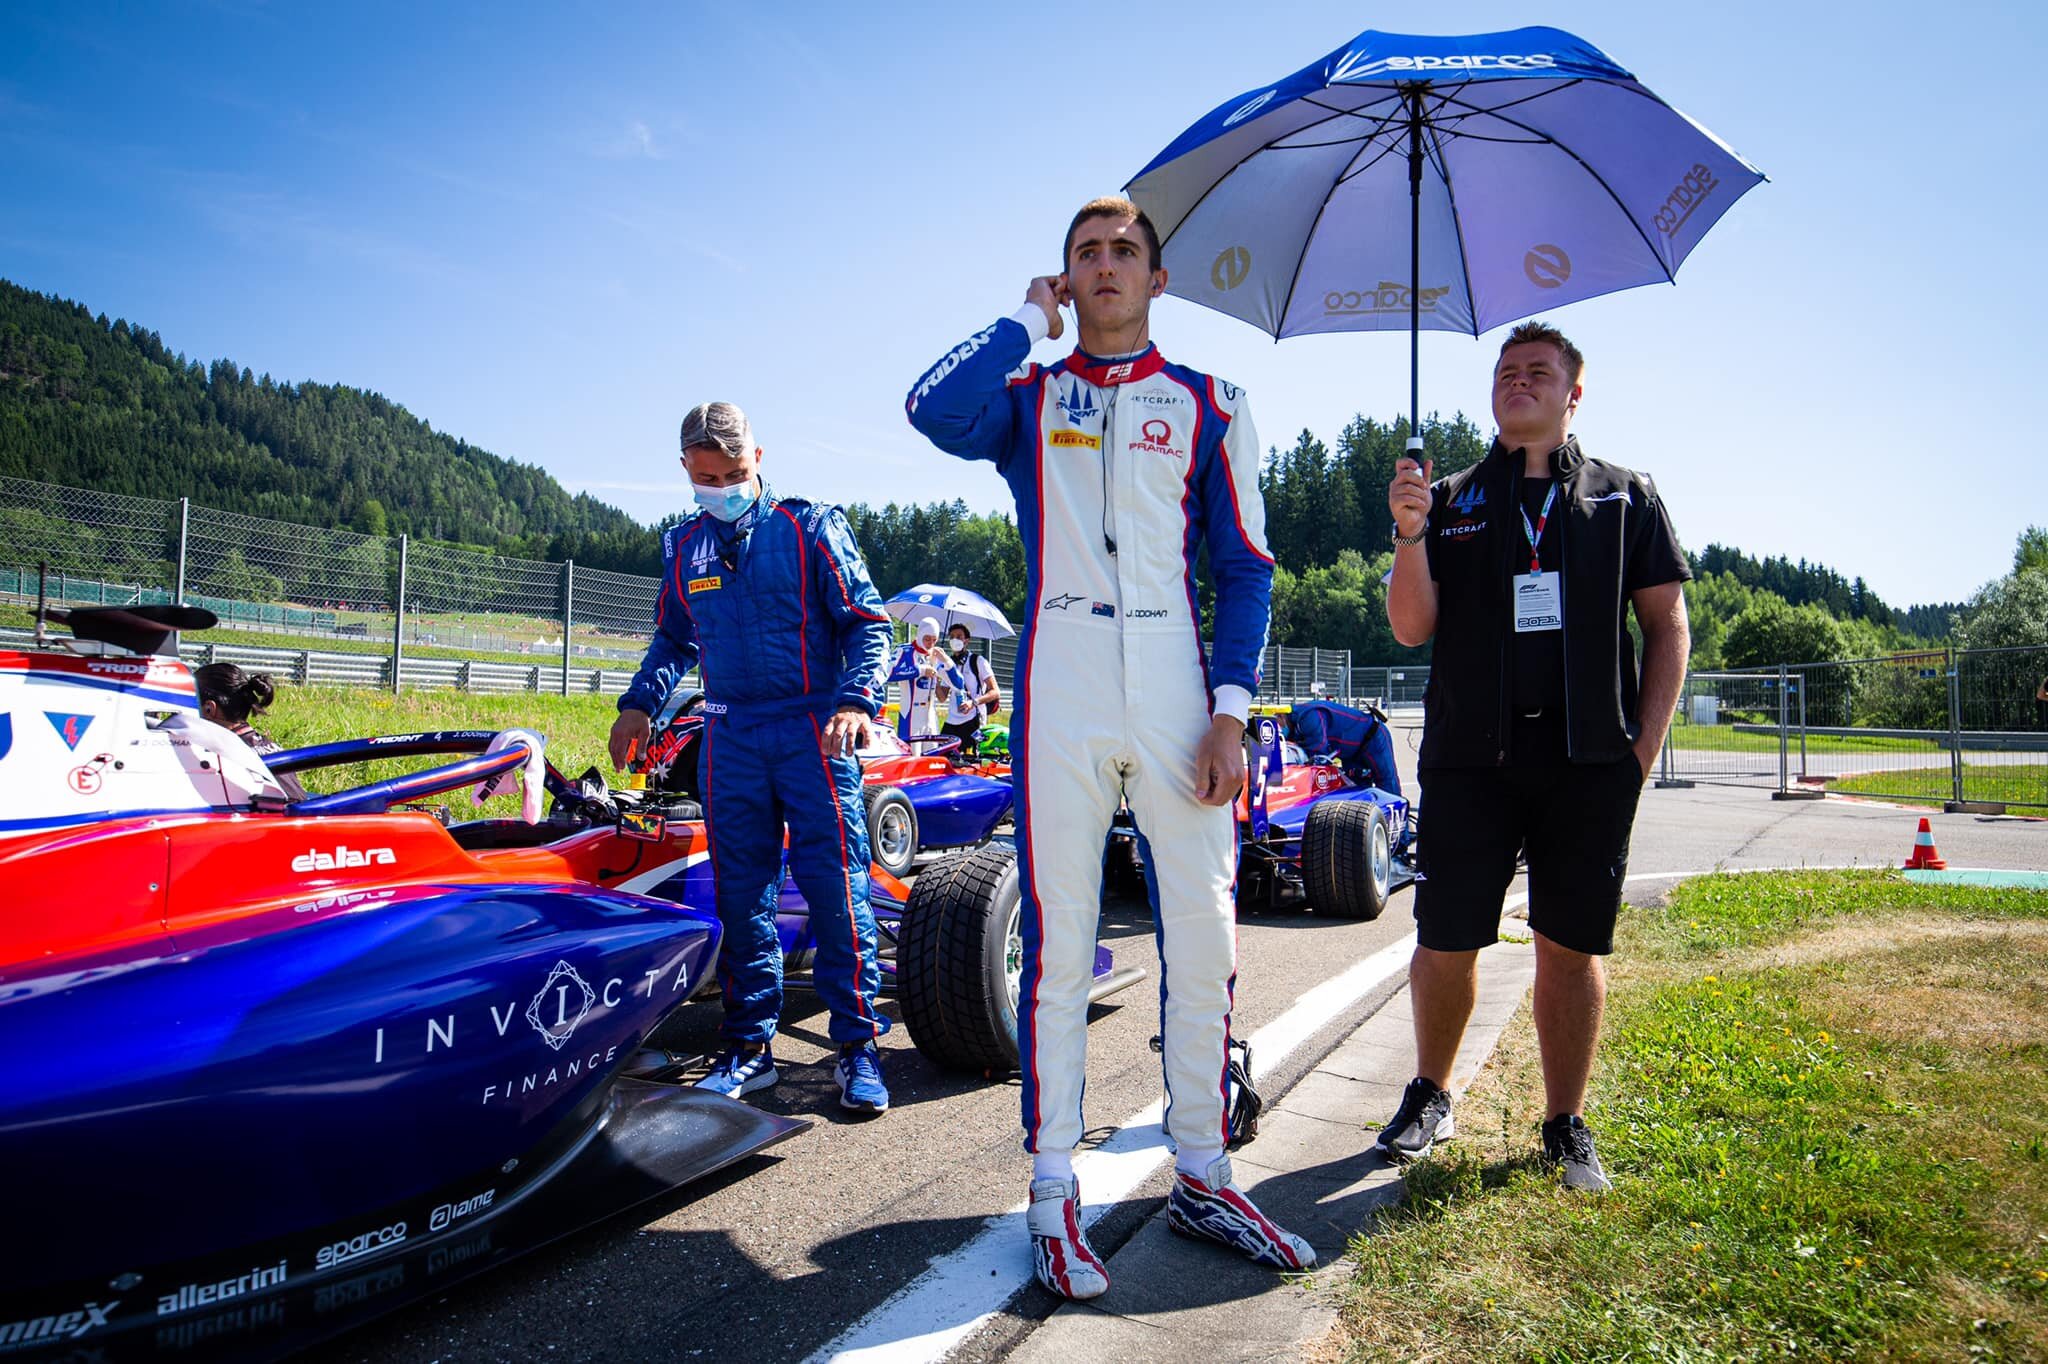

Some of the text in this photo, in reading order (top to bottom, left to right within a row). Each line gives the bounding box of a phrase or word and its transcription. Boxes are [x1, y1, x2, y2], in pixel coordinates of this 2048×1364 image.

[1386, 54, 1557, 70] sparco
[1105, 363, 1134, 380] F3
[1129, 443, 1183, 459] PRAMAC
[1440, 521, 1488, 537] JETCRAFT
[1518, 616, 1560, 628] 2021
[87, 662, 178, 677] TRIDENT
[368, 734, 424, 745] TRIDENT
[434, 731, 442, 742] 4
[291, 846, 397, 872] dallara
[375, 963, 688, 1063] INVICTA
[483, 1046, 606, 1104] FINANCE
[315, 1222, 407, 1271] sparco
[158, 1260, 287, 1315] allegrini
